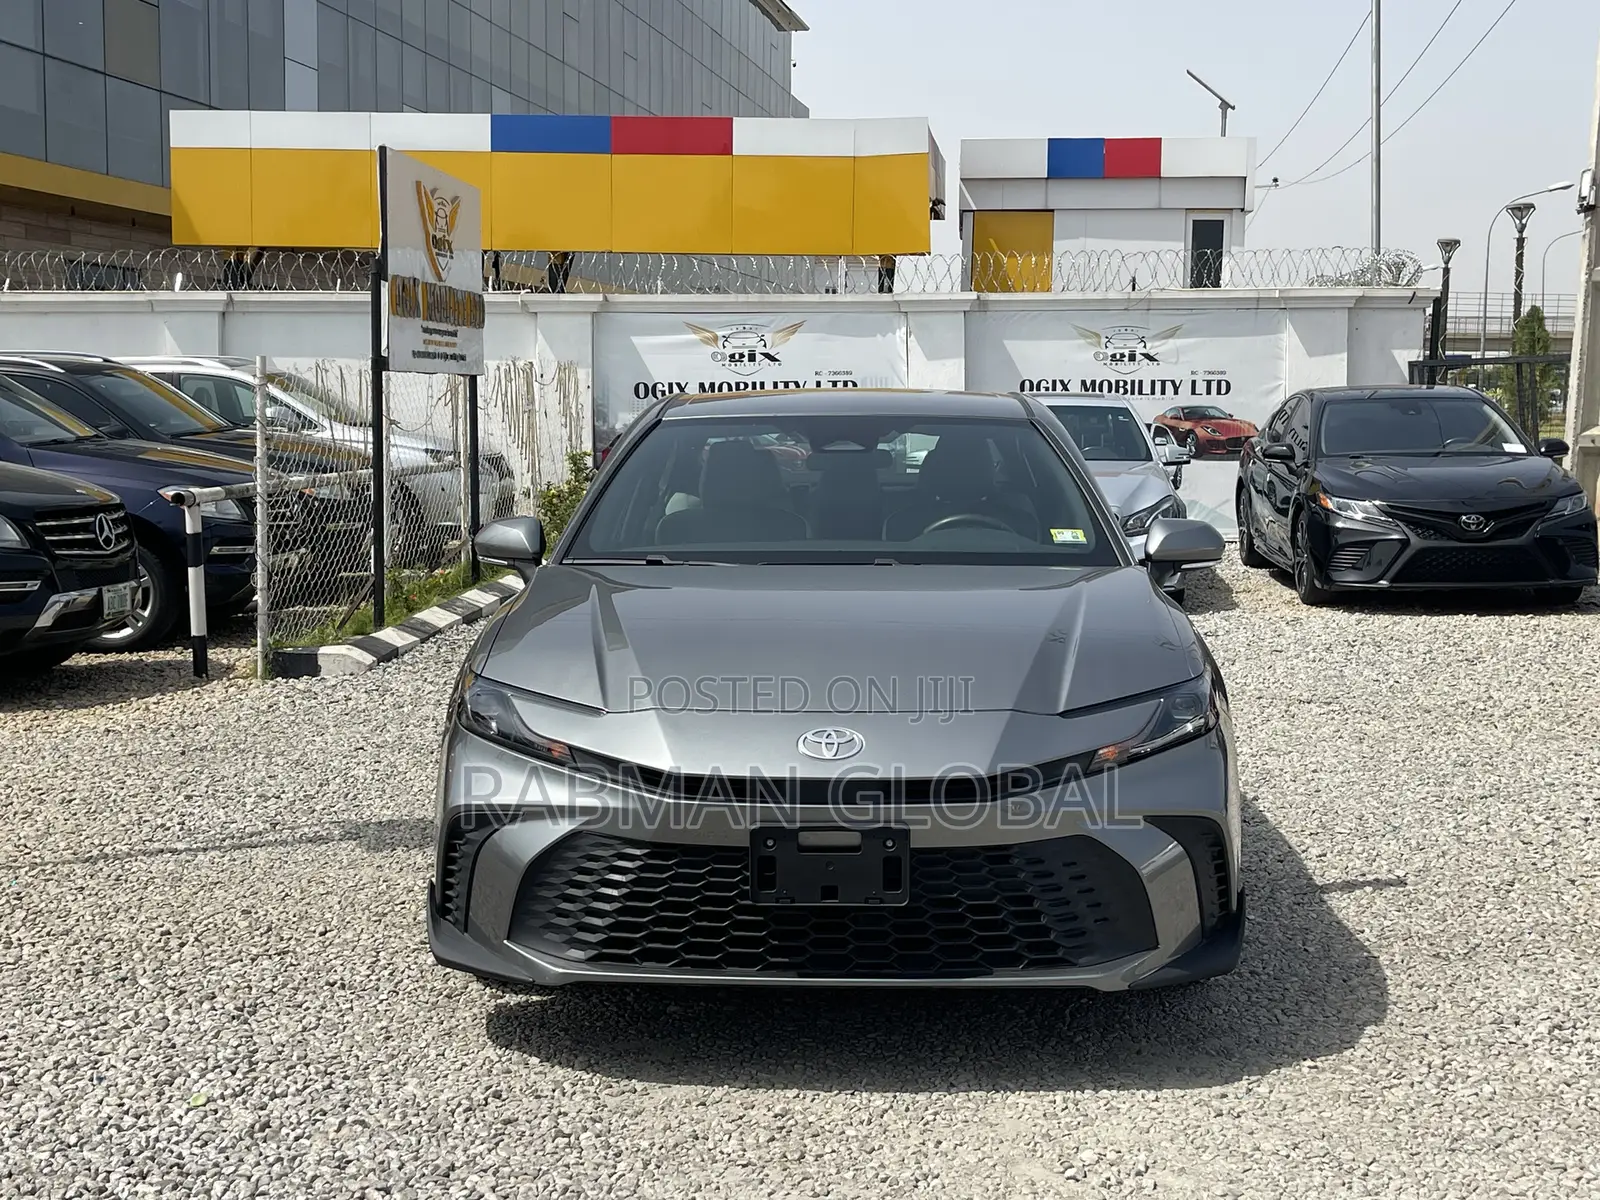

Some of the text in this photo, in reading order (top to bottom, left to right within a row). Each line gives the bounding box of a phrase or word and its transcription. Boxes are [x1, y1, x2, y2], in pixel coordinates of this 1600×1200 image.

[634, 381, 689, 400] OGIX
[1019, 378, 1232, 396] OGIX MOBILITY LTD
